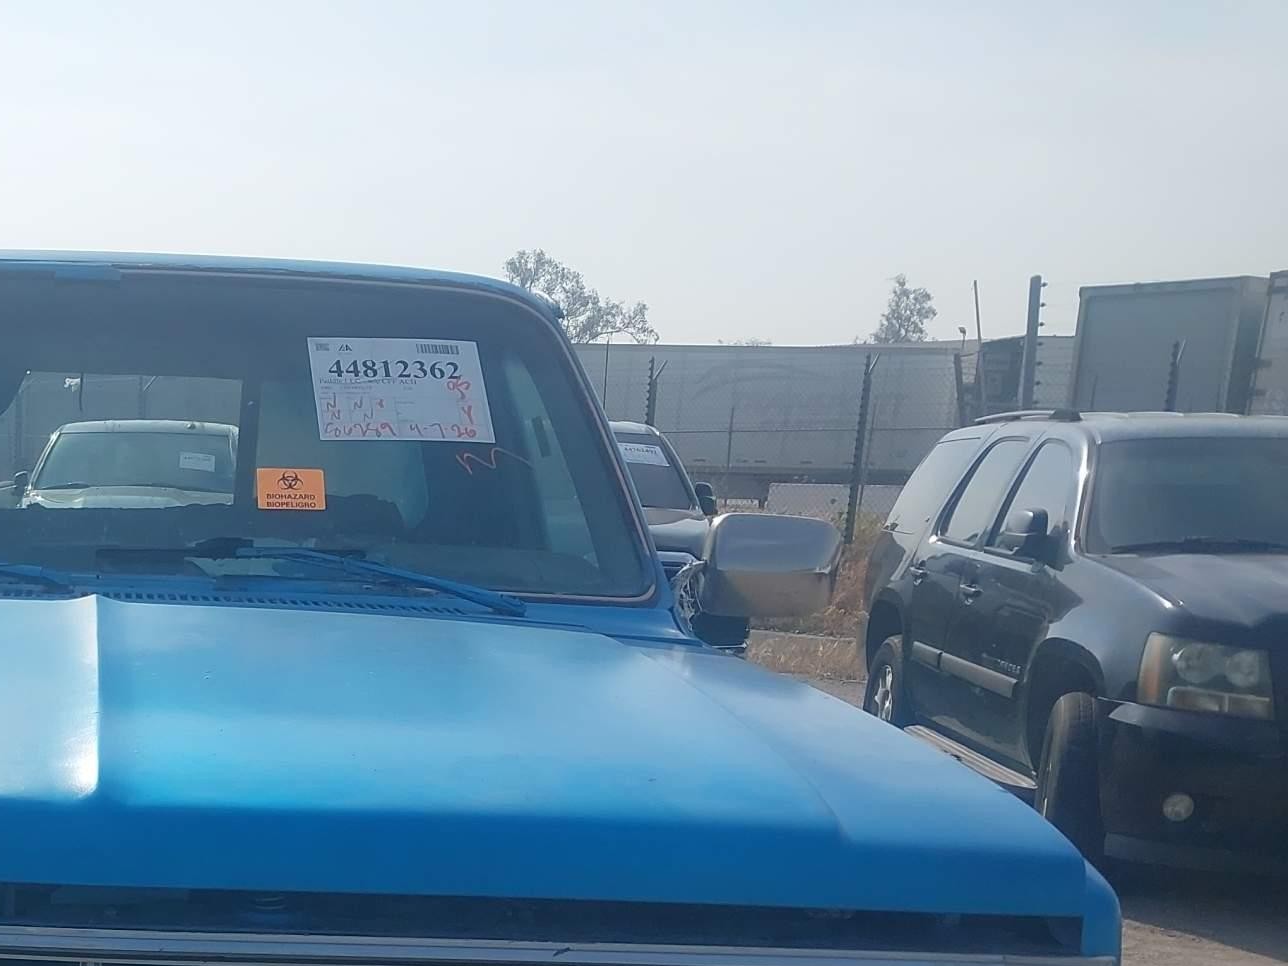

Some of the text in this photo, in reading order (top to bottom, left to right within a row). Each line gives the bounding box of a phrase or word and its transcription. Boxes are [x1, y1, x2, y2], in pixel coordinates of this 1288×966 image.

[328, 359, 462, 380] 44812362
[266, 493, 316, 501] BIOHAZARD
[266, 501, 317, 509] BIOPELIGRO
